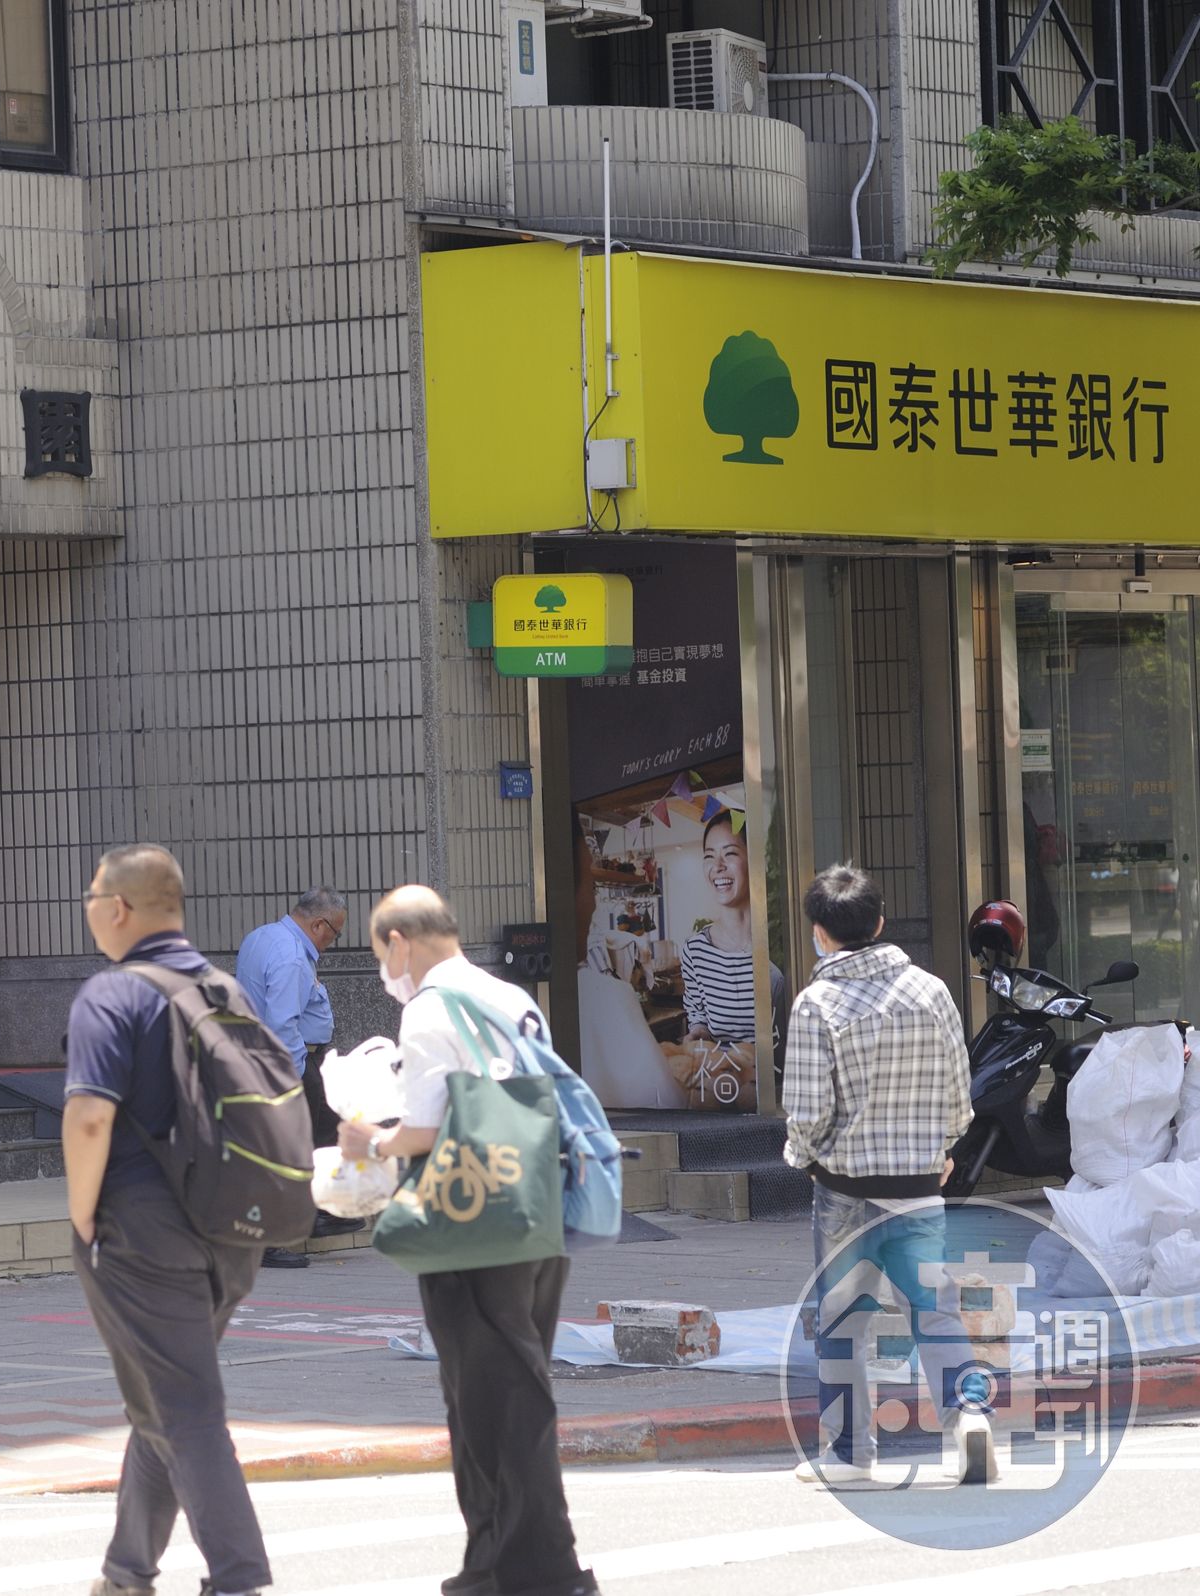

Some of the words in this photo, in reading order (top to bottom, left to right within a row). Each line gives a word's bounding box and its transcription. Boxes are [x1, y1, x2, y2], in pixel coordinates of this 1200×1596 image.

[825, 358, 1169, 464] 國泰世華銀行
[513, 618, 587, 632] 國泰世華銀行
[535, 652, 567, 666] ATM
[637, 667, 687, 685] 基金投資
[654, 747, 682, 767] CURRY
[688, 732, 713, 754] EACH
[715, 723, 730, 749] 88
